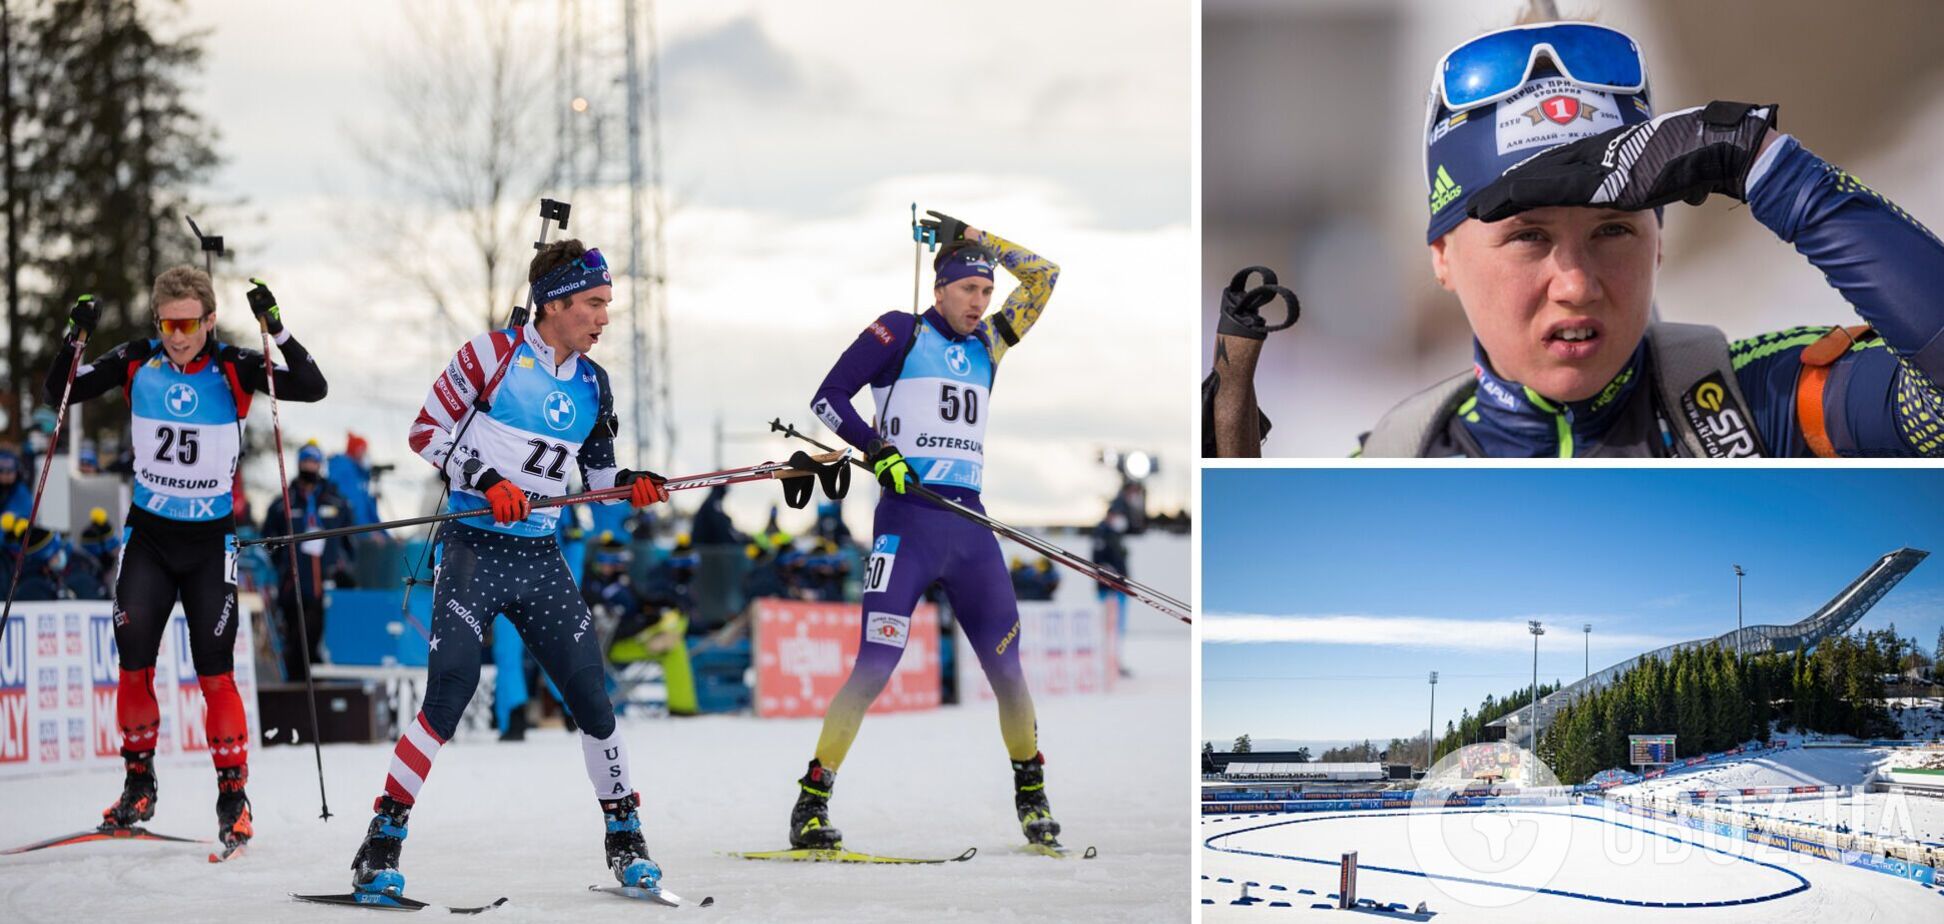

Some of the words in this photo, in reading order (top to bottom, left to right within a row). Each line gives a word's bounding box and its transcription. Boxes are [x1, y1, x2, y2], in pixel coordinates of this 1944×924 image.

[1431, 185, 1462, 215] adidas
[547, 283, 580, 298] maloja
[939, 382, 978, 426] 50
[1479, 376, 1515, 408] LAPUA
[154, 426, 199, 466] 25
[1706, 408, 1762, 458] SR
[141, 467, 219, 490] ÖSTERSUND
[522, 438, 568, 482] 22
[213, 602, 234, 637] CRAFT
[446, 598, 481, 638] maloja
[603, 746, 626, 795] USA
